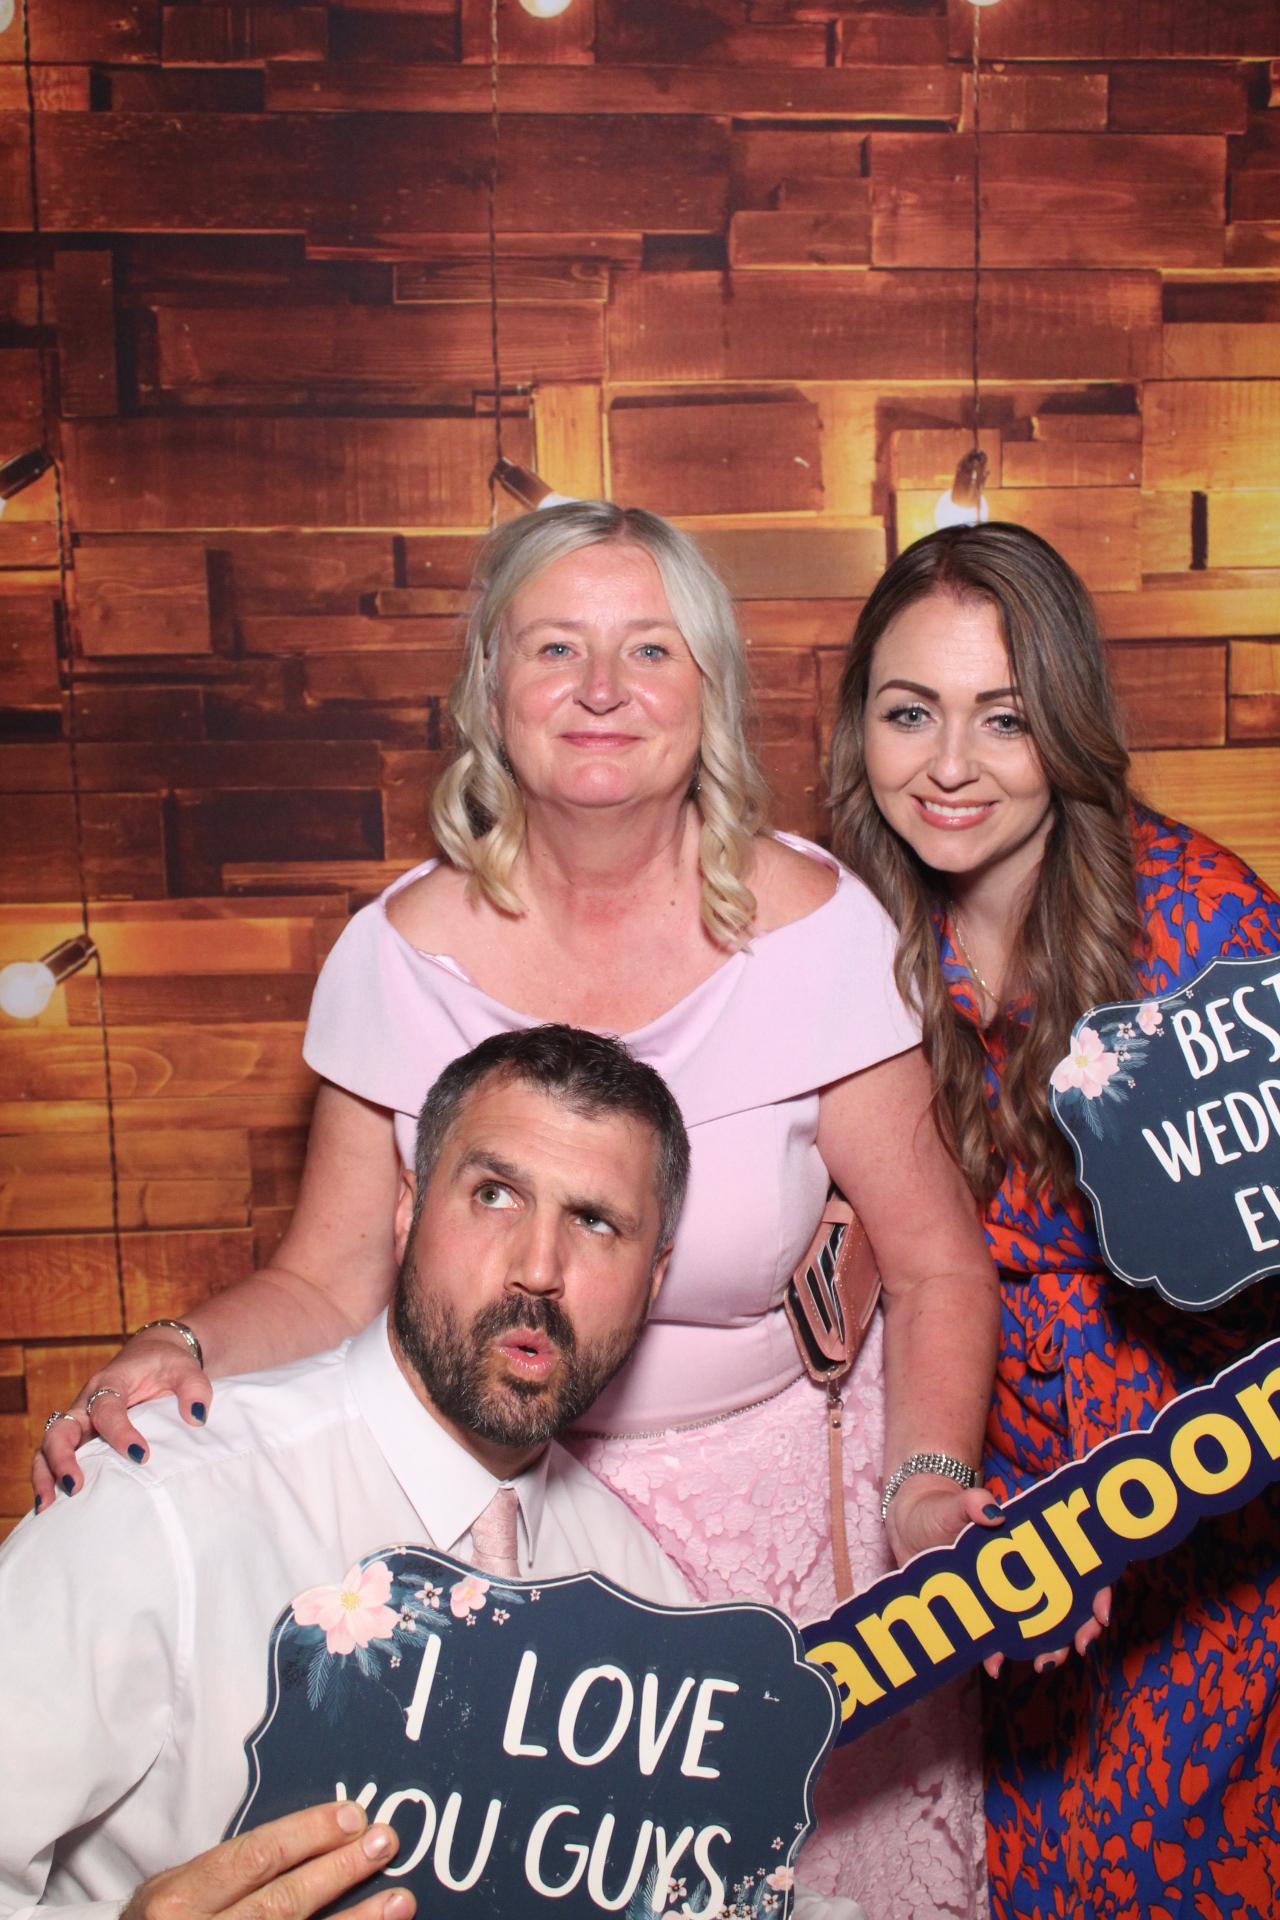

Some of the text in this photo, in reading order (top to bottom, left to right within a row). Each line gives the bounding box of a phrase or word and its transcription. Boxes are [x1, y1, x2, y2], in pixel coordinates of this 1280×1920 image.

[404, 1633, 740, 1779] I LOVE
[524, 1804, 732, 1920] GUYS
